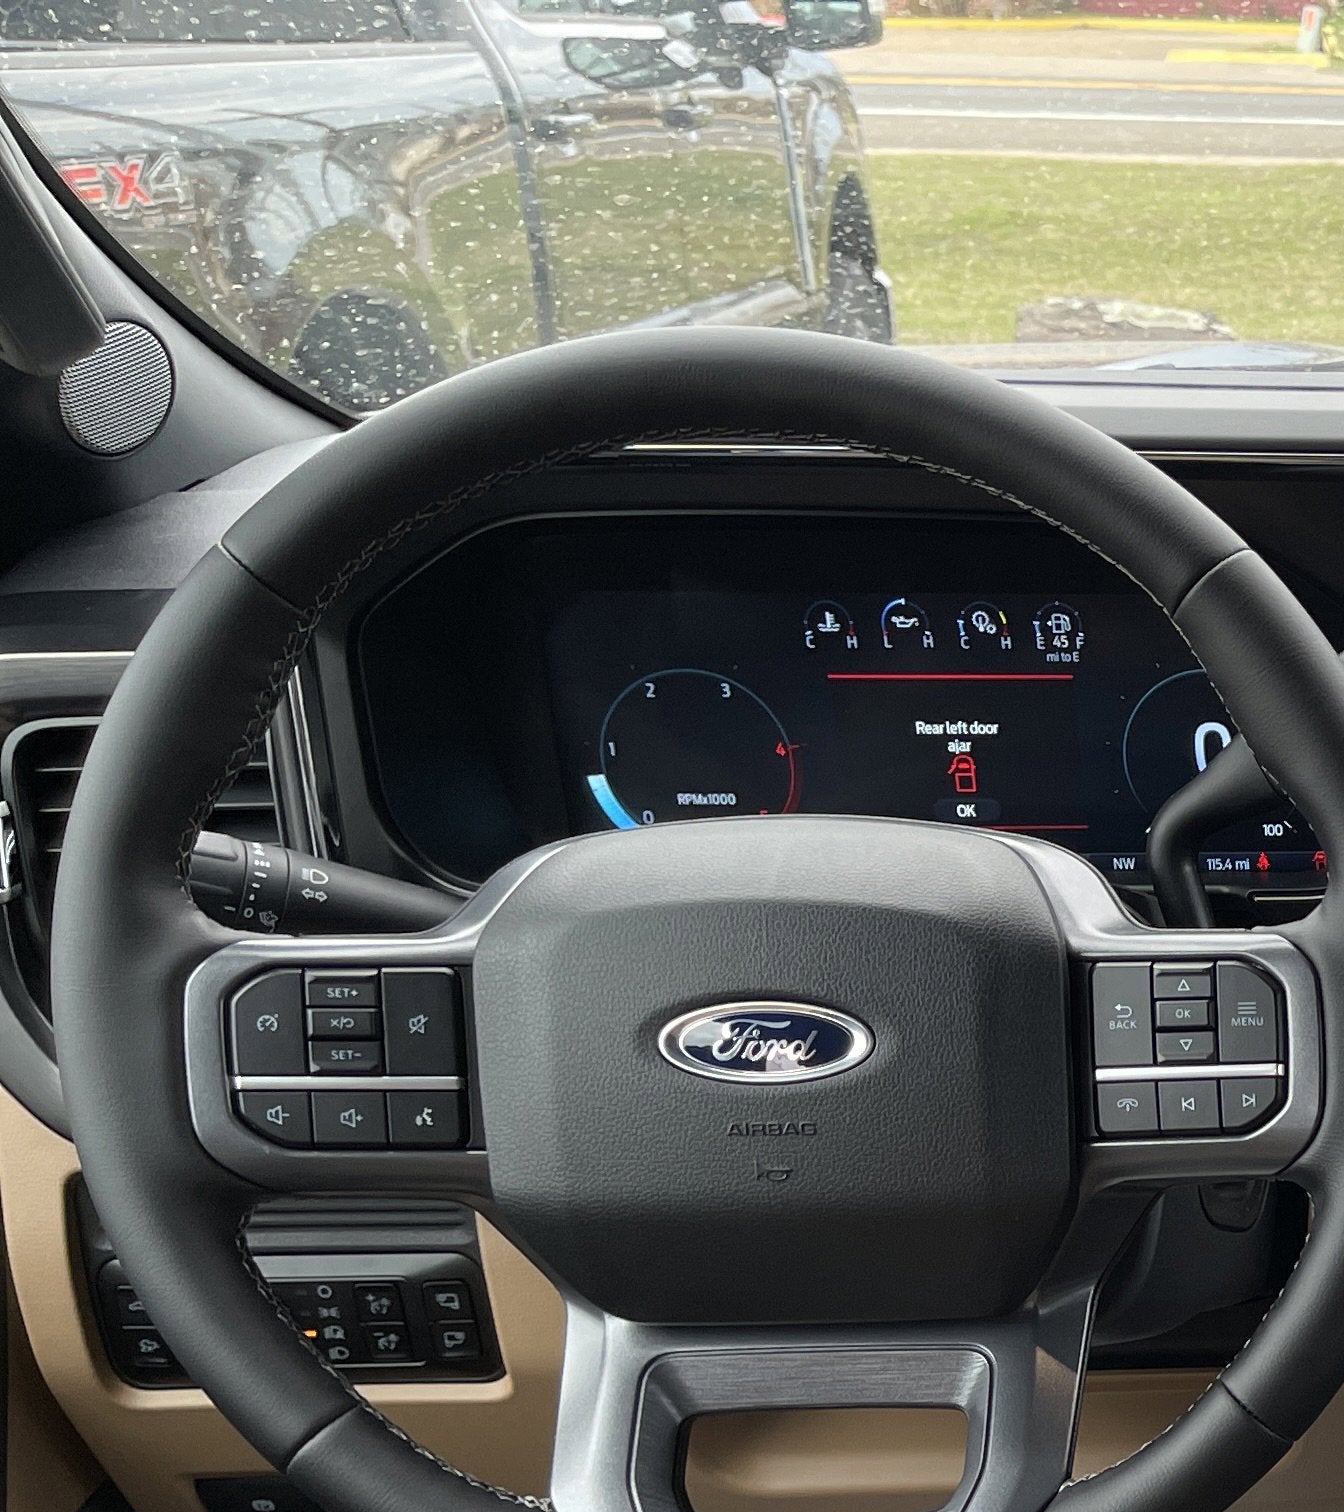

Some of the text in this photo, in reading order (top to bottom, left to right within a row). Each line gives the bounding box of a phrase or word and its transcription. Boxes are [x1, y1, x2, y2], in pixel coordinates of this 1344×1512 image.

[1053, 635, 1069, 648] 45
[645, 682, 656, 698] 2
[721, 682, 732, 698] 3
[915, 720, 999, 735] Rear left door
[608, 742, 616, 757] 1
[775, 741, 787, 757] 4
[947, 738, 972, 755] ajar
[677, 793, 737, 806] RPMx1000
[642, 810, 655, 825] 0
[956, 804, 977, 818] OK
[1262, 823, 1284, 837] 100
[1113, 858, 1135, 871] NW
[1206, 857, 1251, 871] 115.4 mi
[1175, 1008, 1191, 1019] OK
[1109, 1019, 1137, 1031] BACK
[1231, 1016, 1264, 1027] MENU
[711, 1018, 819, 1062] Ford
[727, 1121, 818, 1138] AIRBAG
